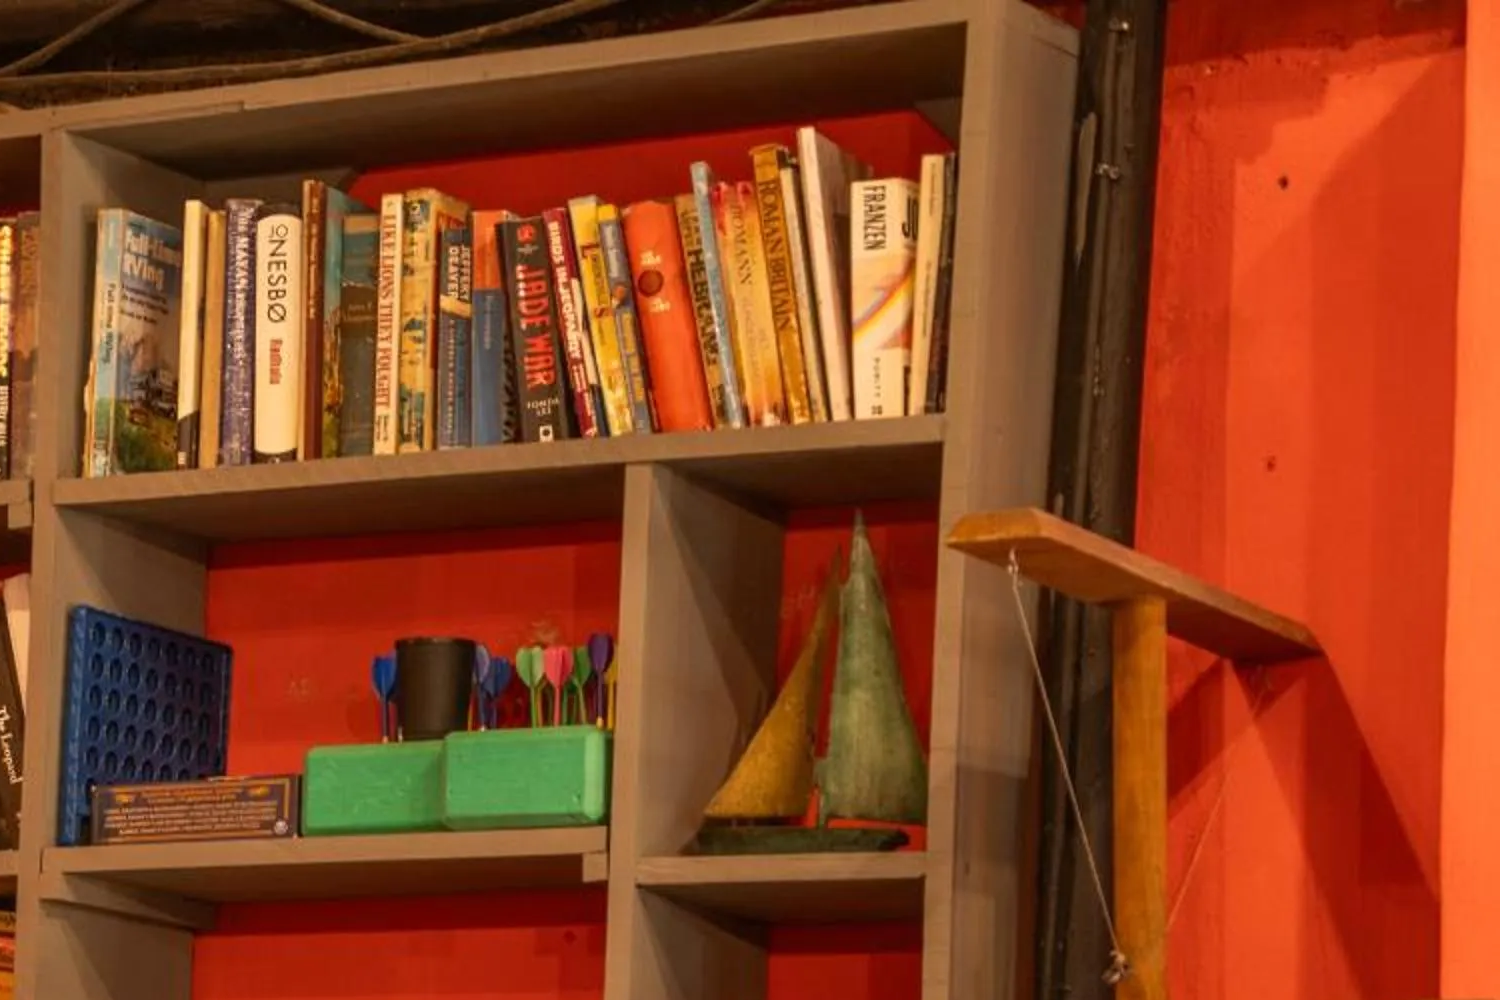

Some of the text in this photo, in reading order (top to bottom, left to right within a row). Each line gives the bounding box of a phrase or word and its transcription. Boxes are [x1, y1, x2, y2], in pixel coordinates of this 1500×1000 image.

[382, 215, 397, 252] LIKE
[548, 221, 565, 264] BIRDS
[862, 185, 888, 250] FRANZEN
[268, 240, 288, 323] NESBØ
[380, 255, 395, 299] LIONS
[757, 181, 794, 332] ROMAN BRITAIN
[379, 304, 393, 344] THEY
[516, 263, 555, 389] JADE WAR
[377, 348, 392, 408] FOUGHT
